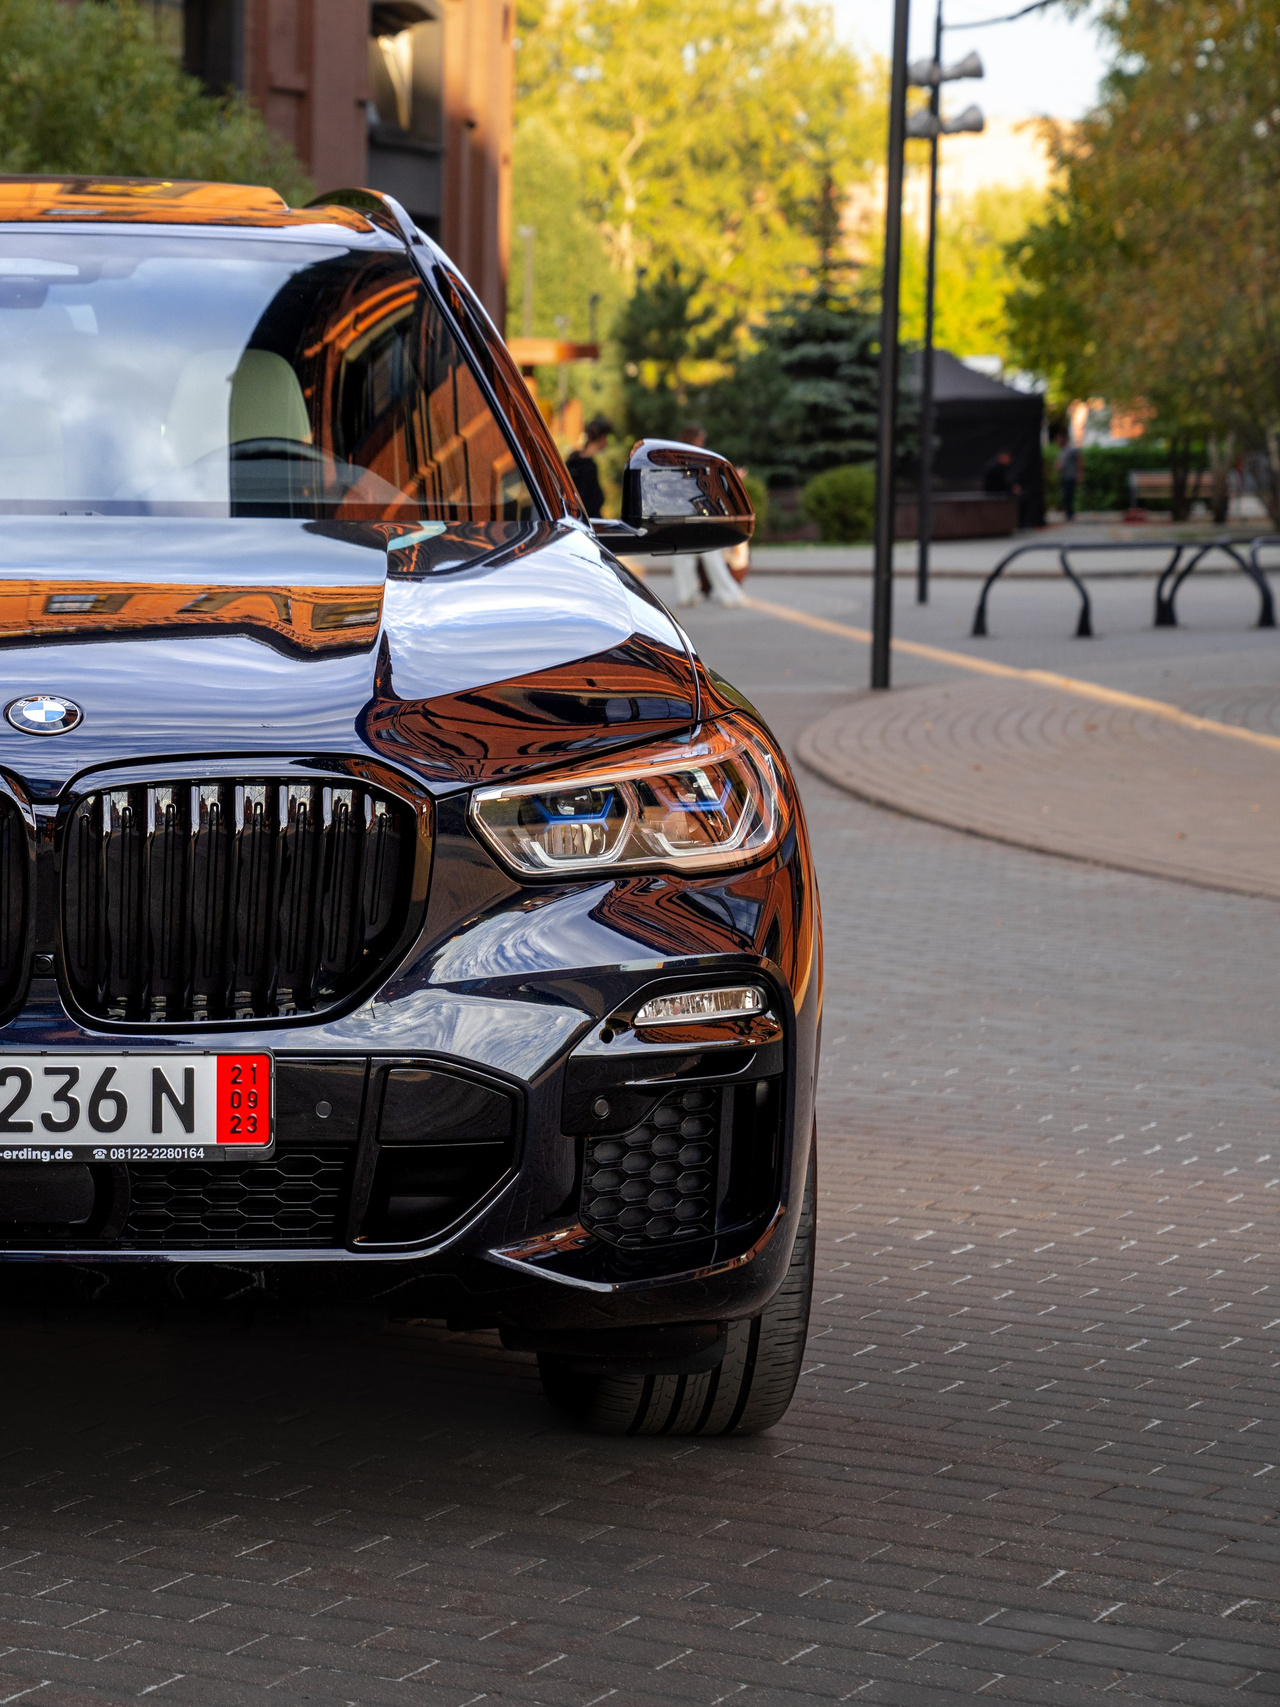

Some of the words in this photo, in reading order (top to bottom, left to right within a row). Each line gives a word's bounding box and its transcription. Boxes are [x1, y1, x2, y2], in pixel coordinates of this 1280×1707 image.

[17, 695, 71, 706] BMW
[230, 1063, 257, 1085] 21
[151, 1066, 196, 1134] N
[230, 1088, 258, 1109] 09
[230, 1113, 258, 1134] 23
[109, 1147, 205, 1160] 08122-2280164
